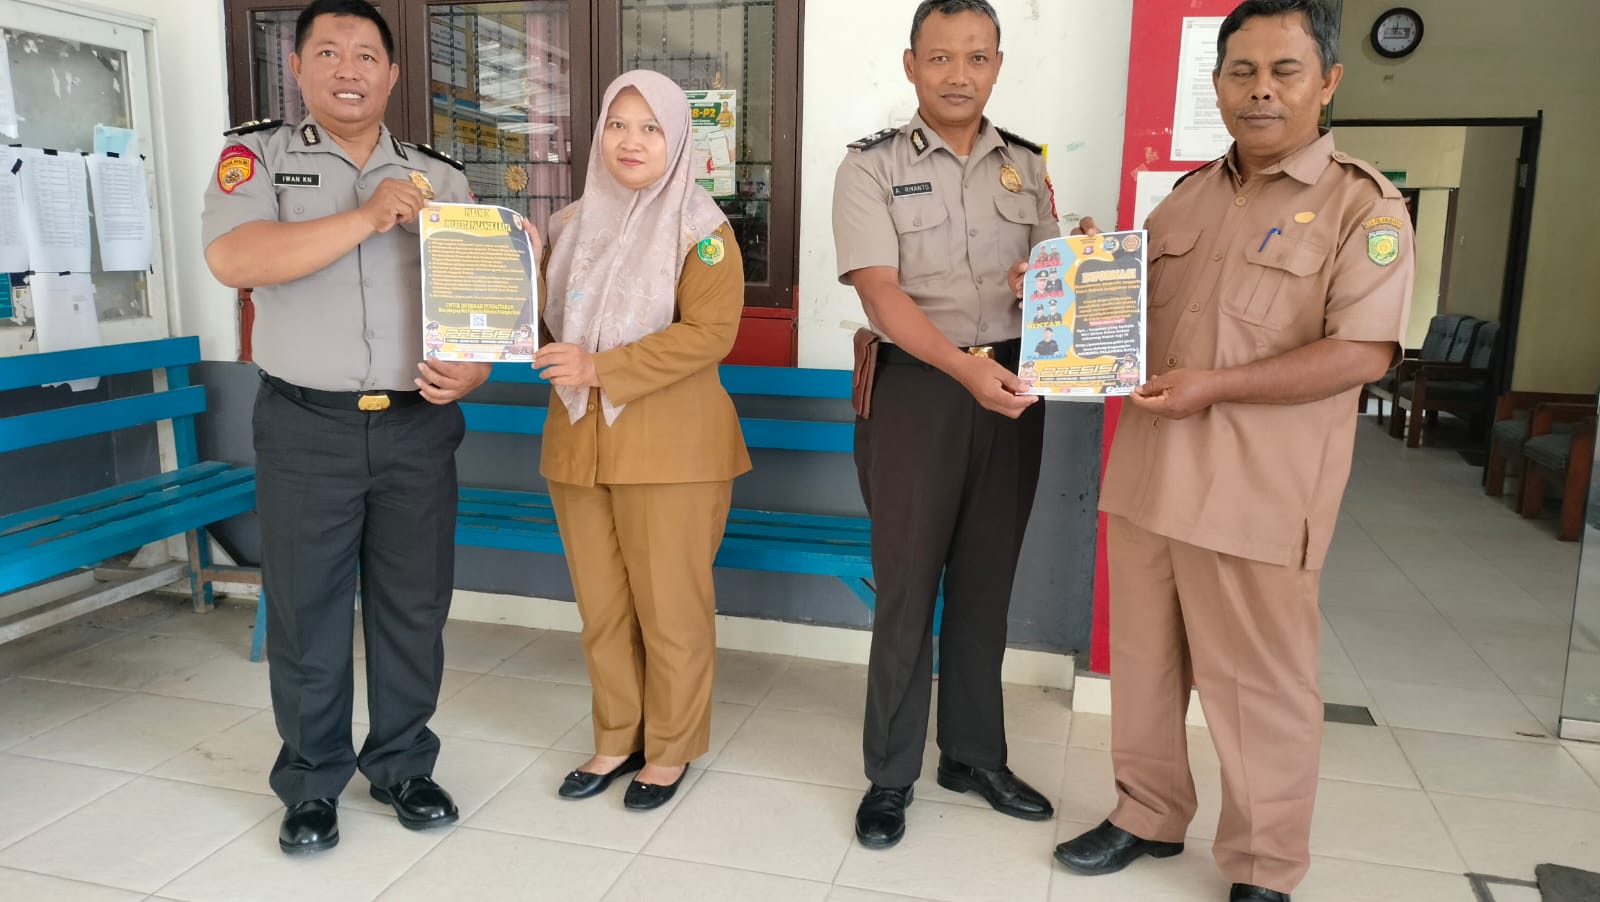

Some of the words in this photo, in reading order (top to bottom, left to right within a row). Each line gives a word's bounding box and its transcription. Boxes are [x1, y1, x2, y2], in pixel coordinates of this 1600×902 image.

[282, 175, 300, 183] IWAN
[445, 328, 515, 339] PRESISI
[1040, 363, 1119, 377] PRESISI
